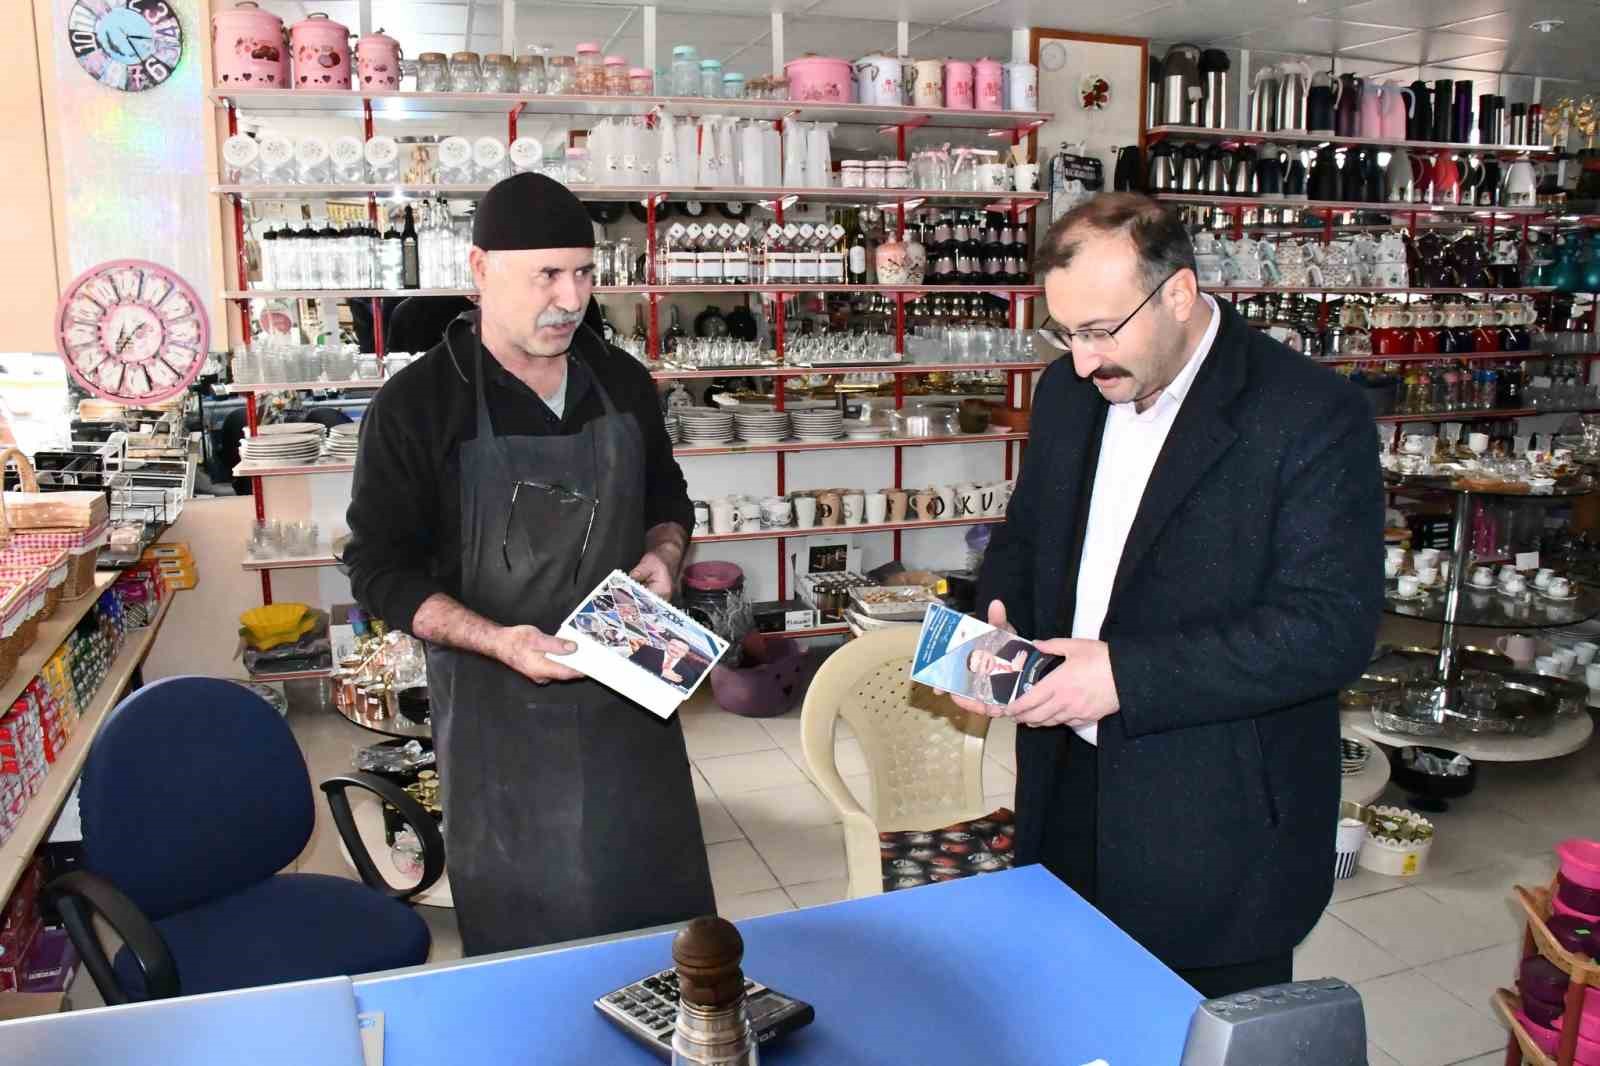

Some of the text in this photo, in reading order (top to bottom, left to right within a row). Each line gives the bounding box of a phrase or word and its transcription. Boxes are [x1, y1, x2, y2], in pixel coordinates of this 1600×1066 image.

[144, 1, 168, 24] 3
[72, 32, 97, 53] 10
[145, 57, 167, 81] 6
